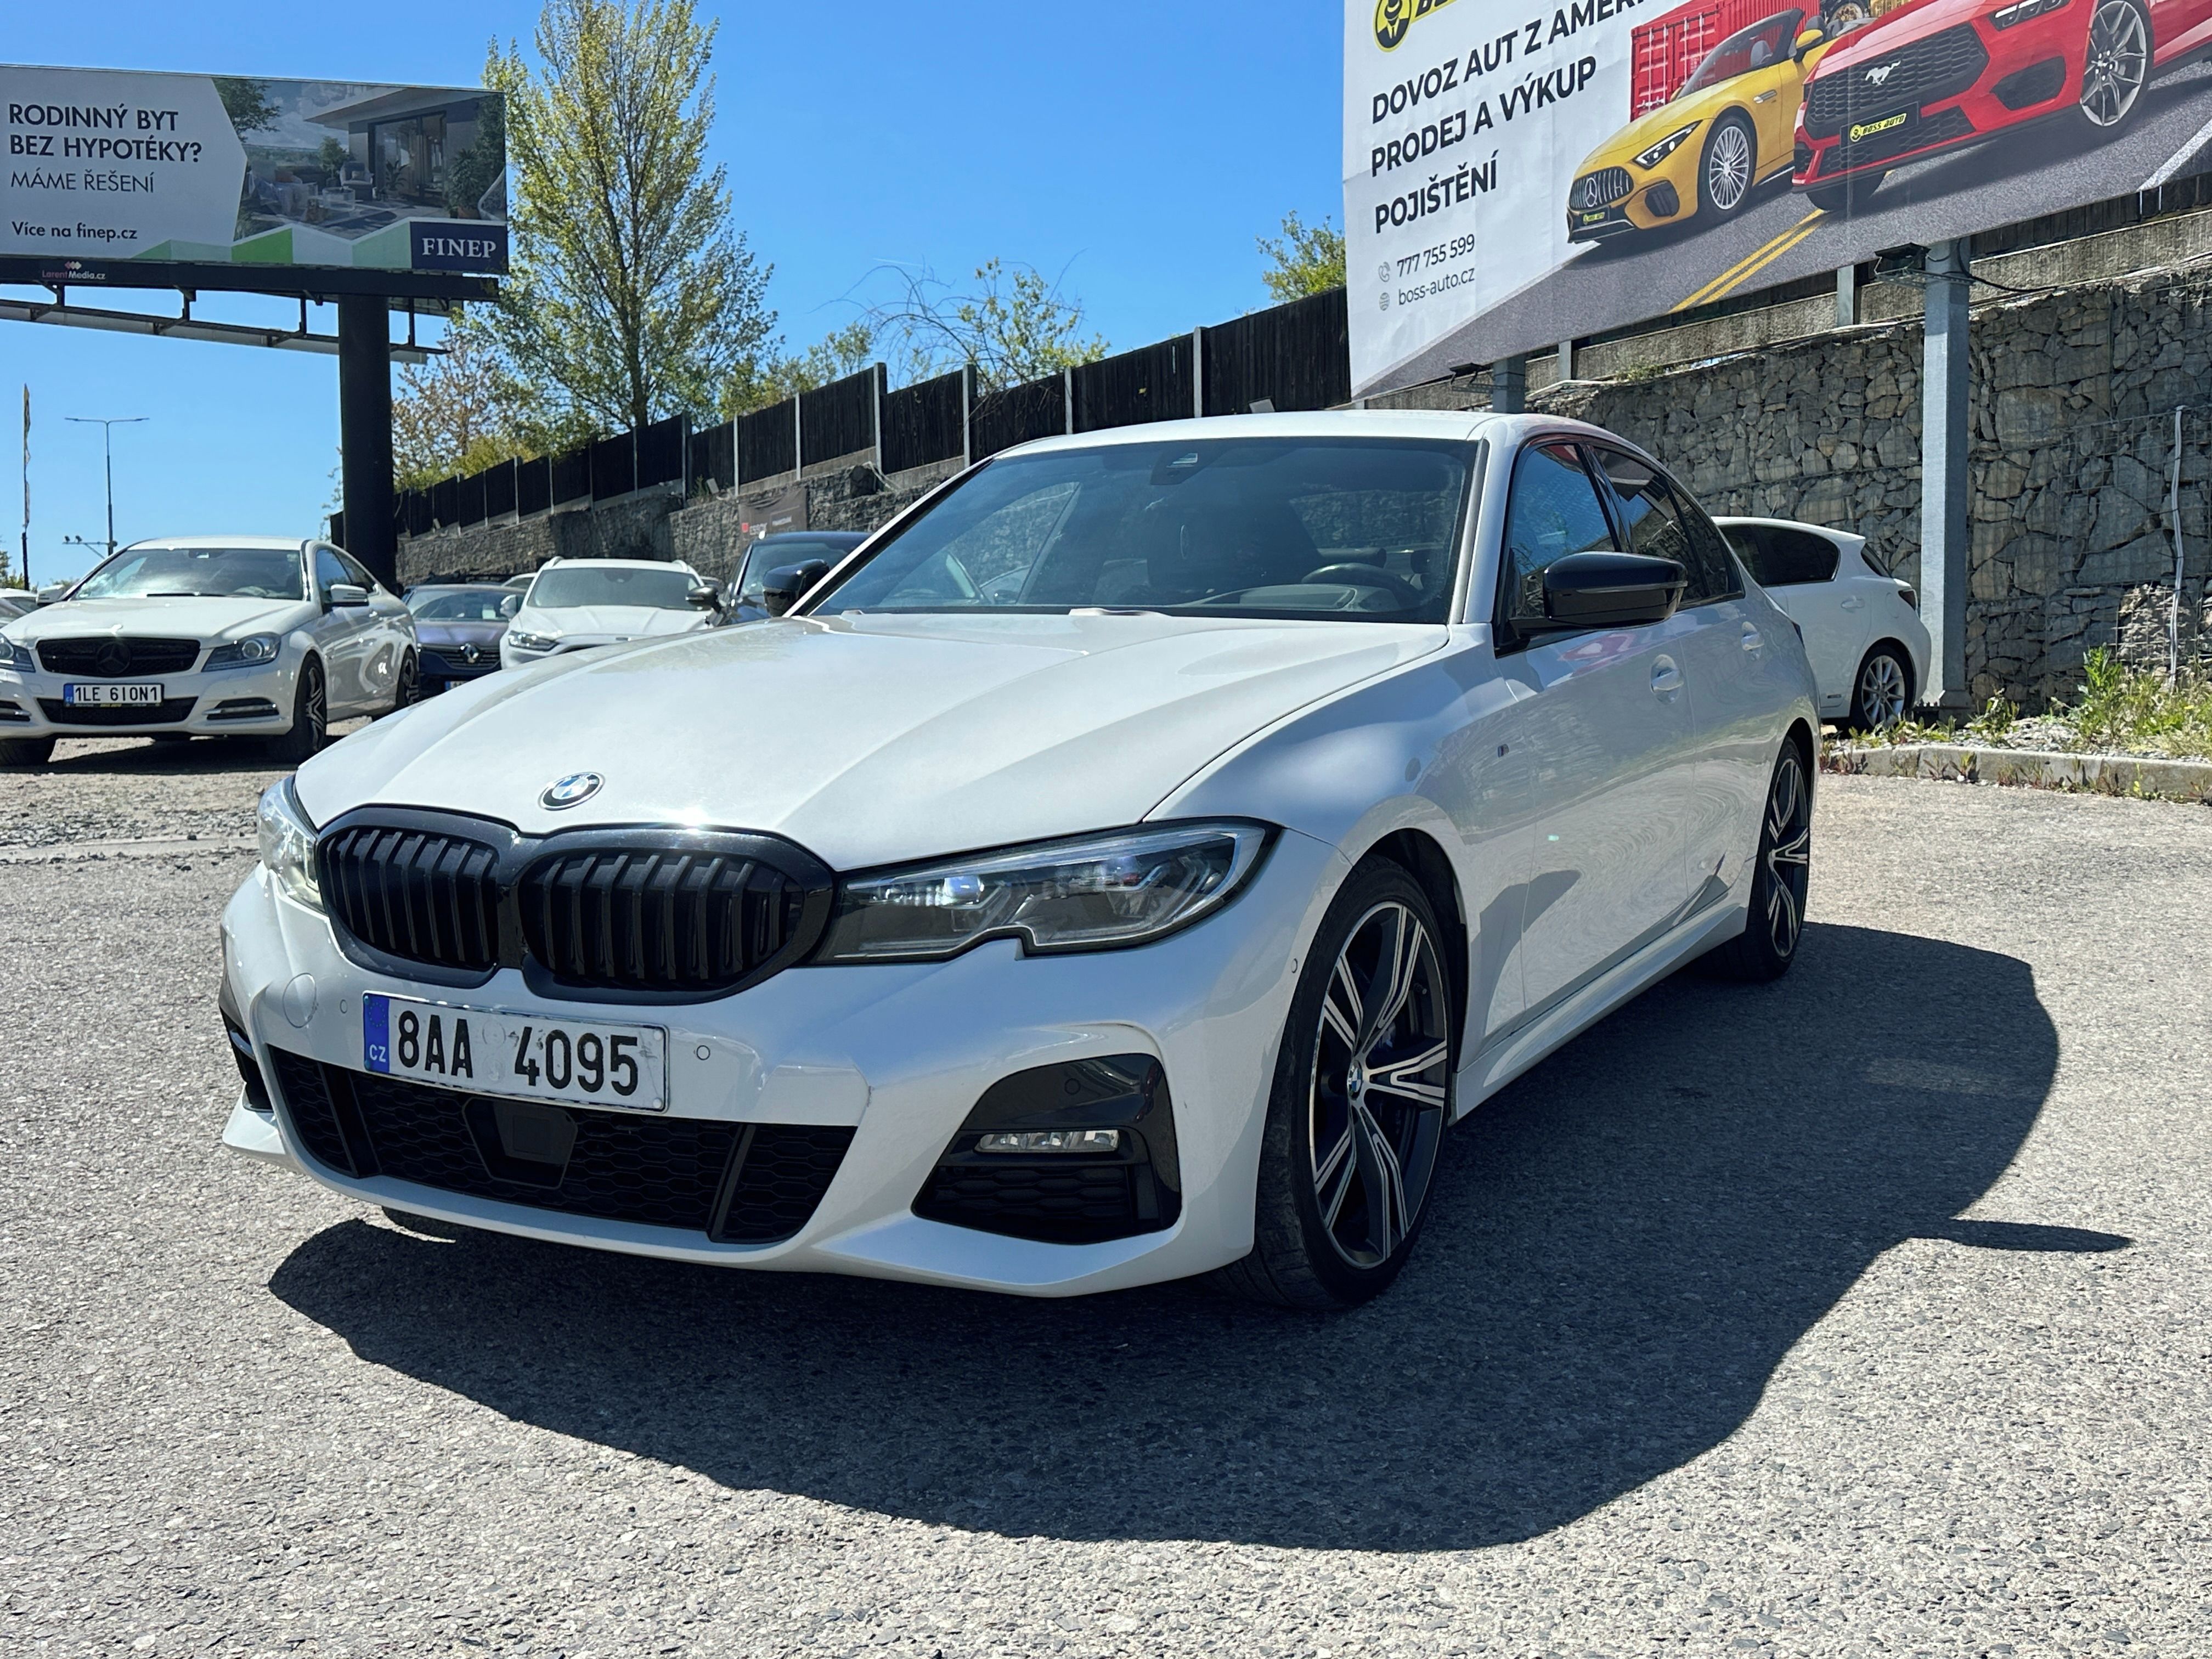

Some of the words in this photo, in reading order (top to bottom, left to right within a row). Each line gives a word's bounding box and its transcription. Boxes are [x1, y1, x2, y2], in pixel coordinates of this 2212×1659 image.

[1373, 58, 1458, 124] DOVOZ
[1463, 30, 1518, 83] AUT
[1524, 19, 1542, 55] Z
[9, 103, 128, 129] RODINNÝ
[137, 109, 179, 131] BYT
[1371, 110, 1466, 178] PRODEJ
[1472, 101, 1494, 136] A
[1499, 55, 1597, 122] VÝKUP
[10, 134, 54, 156] BEZ
[64, 134, 202, 162] HYPOTÉKY?
[10, 167, 77, 190] MÁME
[84, 168, 155, 193] ŘEŠENÍ
[1375, 149, 1499, 234] POJIŠTĚNÍ
[12, 221, 46, 236] Více
[51, 227, 72, 238] na
[76, 222, 138, 243] finep.cz
[421, 238, 496, 258] FINEP
[1397, 253, 1421, 278] 777
[1423, 244, 1447, 268] 755
[1449, 234, 1475, 259] 599
[1398, 267, 1475, 306] boss-auto.cz
[75, 687, 101, 702] 1LE
[369, 1044, 387, 1063] CZ
[398, 1010, 473, 1079] 8AA
[514, 1026, 639, 1096] 4095
